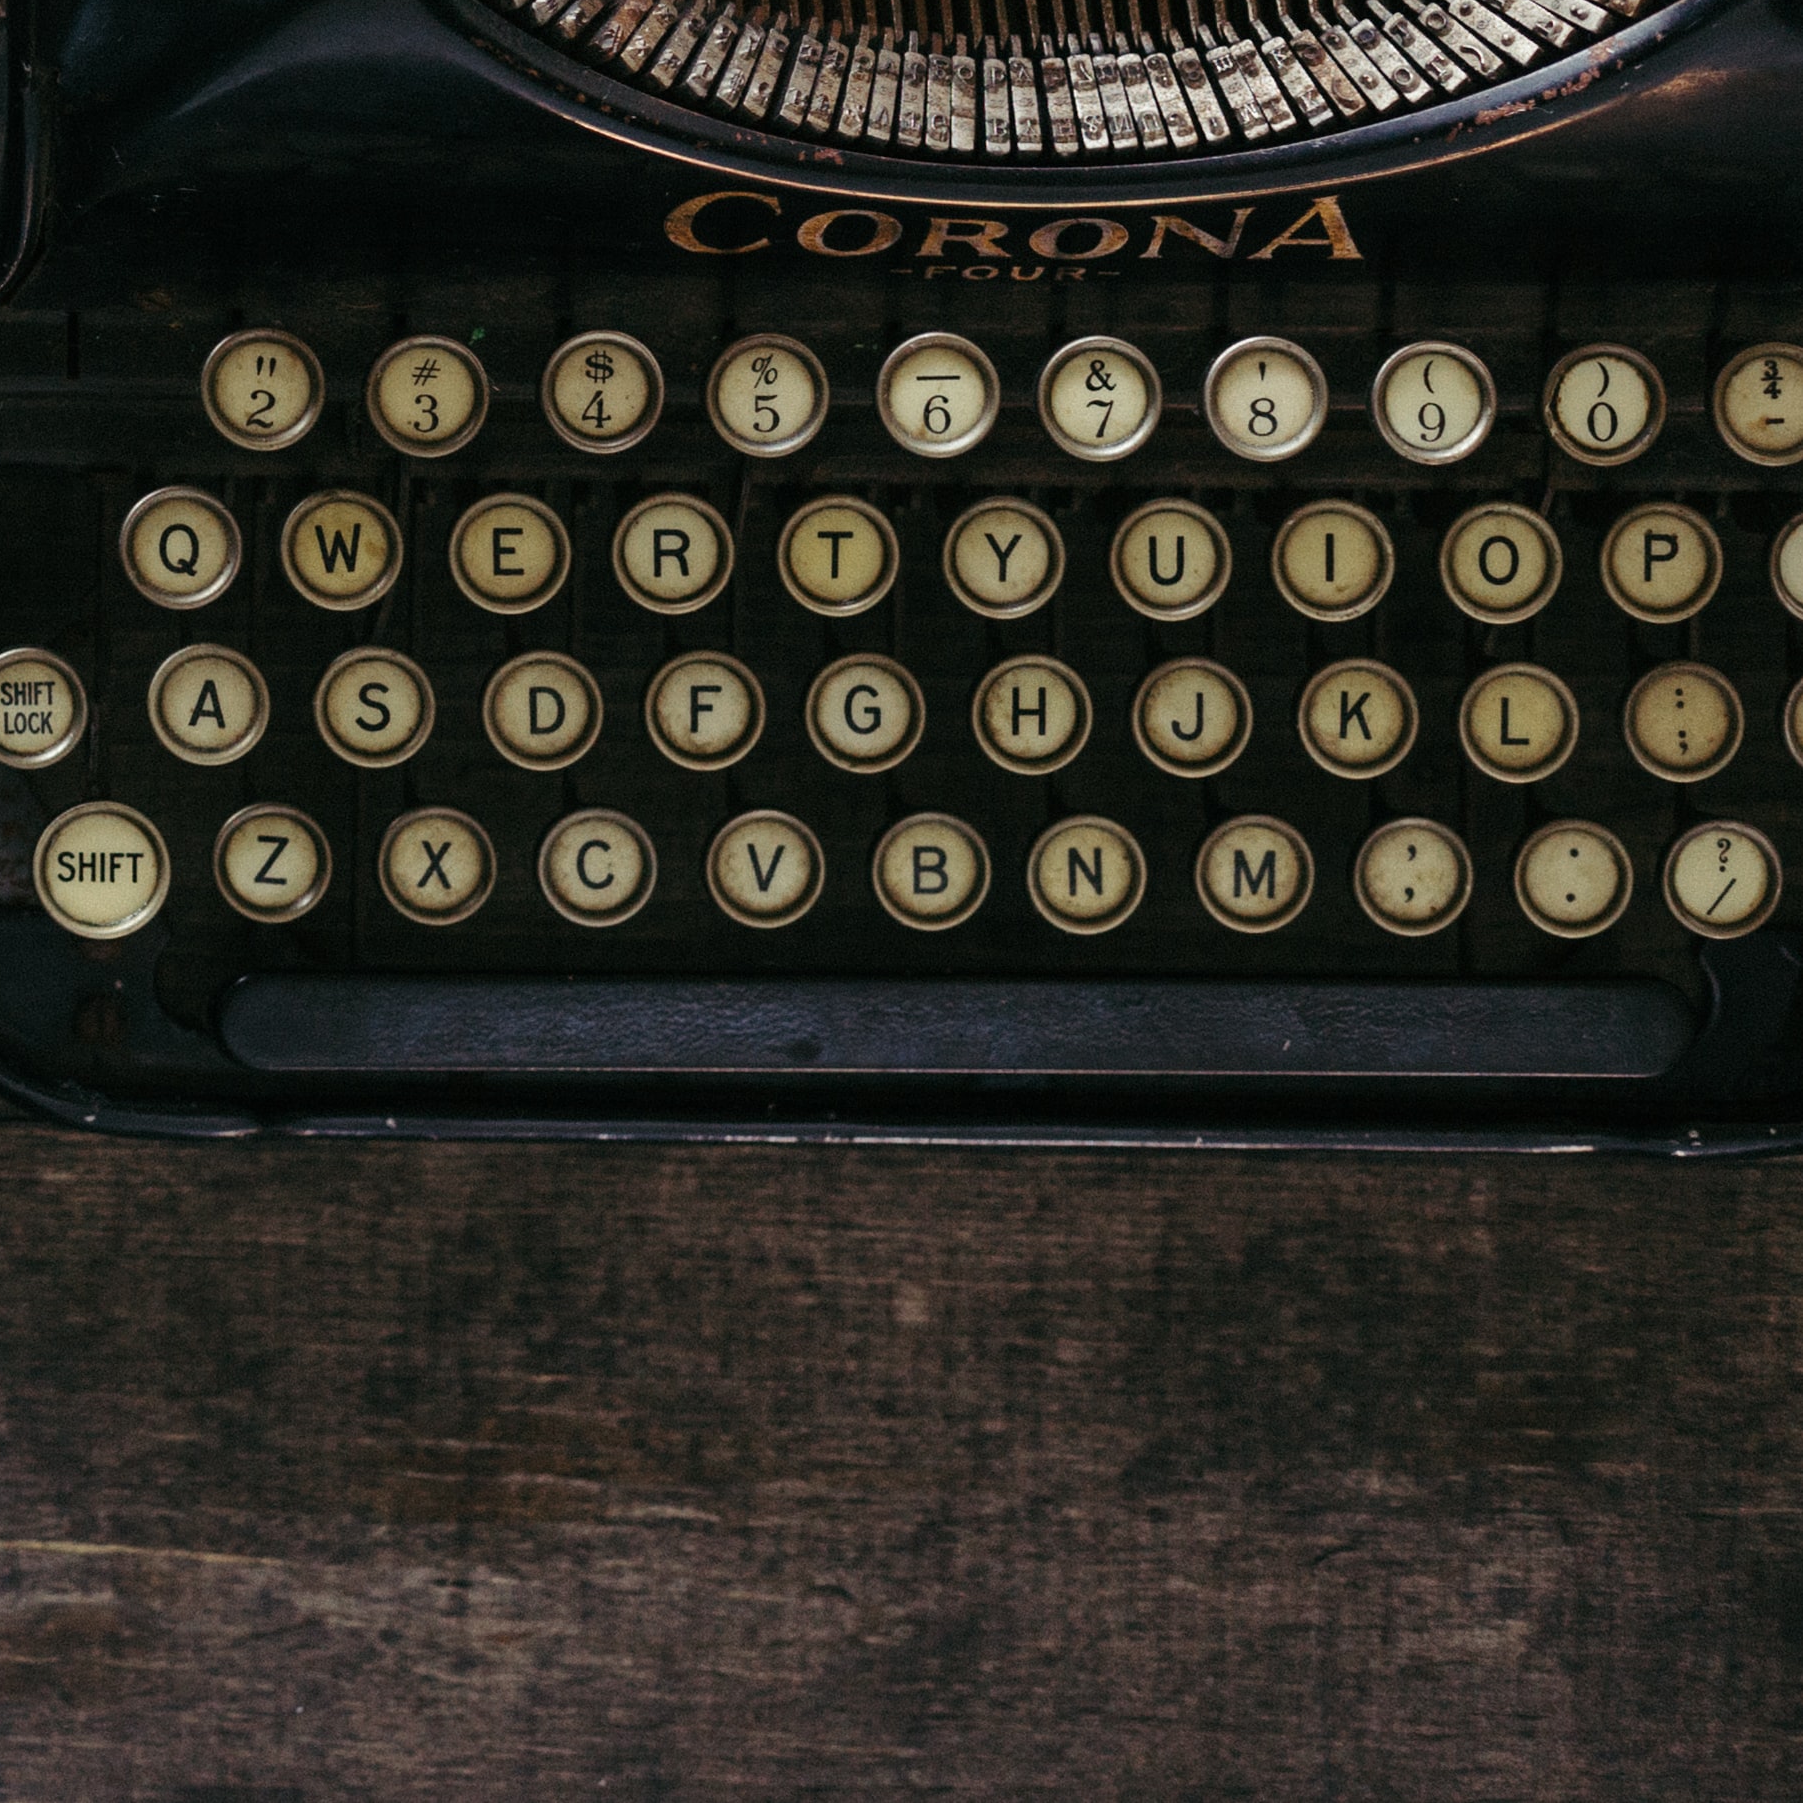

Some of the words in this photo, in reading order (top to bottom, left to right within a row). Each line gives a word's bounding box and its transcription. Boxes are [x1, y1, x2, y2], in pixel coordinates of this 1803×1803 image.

[662, 191, 1364, 261] CORONA
[412, 358, 440, 385] #
[585, 350, 615, 382] $
[750, 352, 779, 387] %
[1085, 358, 1114, 392] &
[1422, 360, 1434, 393] (
[1598, 362, 1610, 397] )
[245, 389, 276, 430] 2
[413, 394, 440, 434] 3
[579, 390, 612, 430] 4
[753, 395, 780, 433] 5
[922, 395, 952, 434] 6
[1088, 399, 1114, 439] 7
[1248, 398, 1278, 436] 8
[1418, 403, 1446, 441] 9
[158, 523, 200, 577] Q
[314, 522, 362, 574] W
[492, 527, 525, 576] E
[653, 528, 691, 578] R
[817, 530, 854, 579] T
[984, 532, 1022, 583] Y
[1148, 535, 1185, 586] U
[1325, 533, 1335, 582] I
[1478, 535, 1520, 586] O
[1644, 529, 1679, 582] P
[0, 680, 56, 706] SHIFT
[189, 679, 226, 729] A
[355, 682, 391, 733] S
[528, 686, 566, 735] D
[689, 684, 722, 734] F
[843, 684, 882, 735] G
[1011, 686, 1047, 736] H
[1171, 692, 1204, 742] J
[1339, 690, 1372, 740] K
[1500, 696, 1530, 746] L
[3, 711, 54, 736] LOCK
[57, 851, 144, 883] SHIFT
[254, 834, 290, 885] Z
[417, 840, 452, 890] X
[576, 839, 614, 890] C
[747, 843, 786, 892] V
[912, 845, 949, 895] B
[1067, 847, 1103, 896] N
[1233, 849, 1276, 900] M
[1716, 837, 1732, 873] ?
